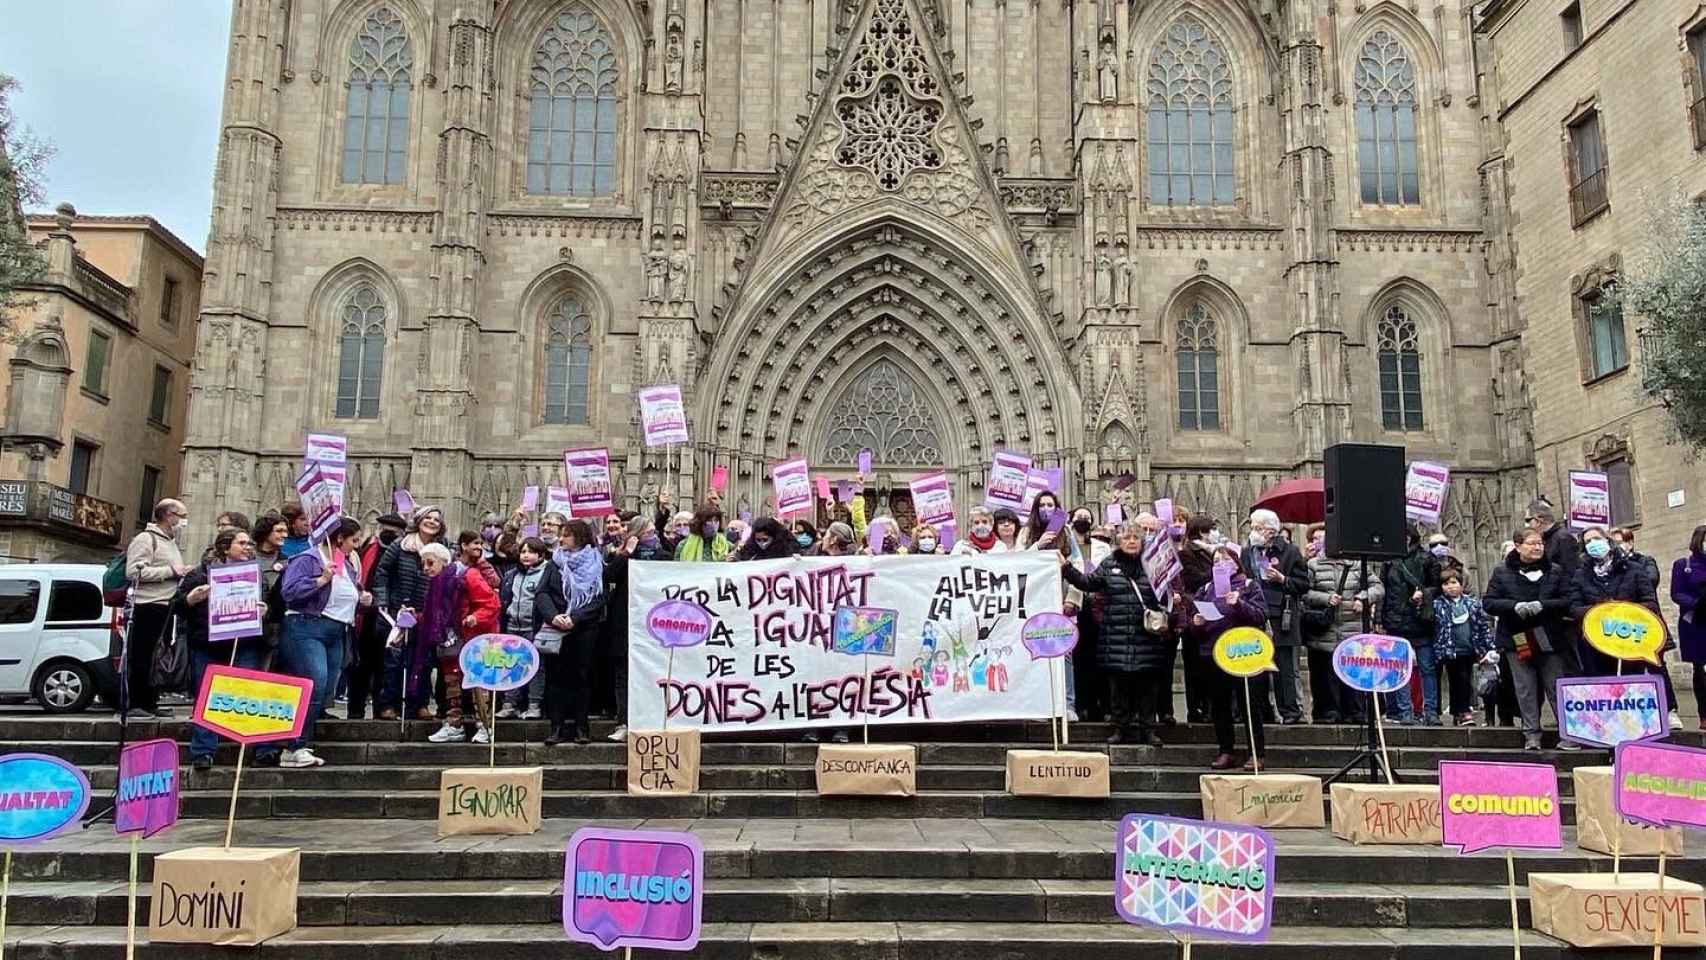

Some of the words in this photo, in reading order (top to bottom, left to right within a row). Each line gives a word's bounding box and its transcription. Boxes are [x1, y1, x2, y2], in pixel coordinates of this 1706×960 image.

[715, 576, 741, 607] LA
[747, 566, 875, 614] DIGNITAT
[935, 565, 1011, 599] ALCEM
[927, 597, 953, 621] LA
[1601, 618, 1648, 643] VOT
[706, 655, 736, 678] DE
[754, 654, 796, 679] LES
[208, 694, 294, 722] ESCOLTA
[657, 680, 768, 724] DONES
[771, 691, 790, 720] A
[1565, 697, 1658, 713] CONFIANÇA
[635, 735, 679, 755] OPU
[1029, 762, 1092, 778] LENTITUD
[446, 783, 528, 824] IGNORAR
[1124, 853, 1265, 892] INTEGRACIÓ
[1584, 892, 1700, 934] SEXISME
